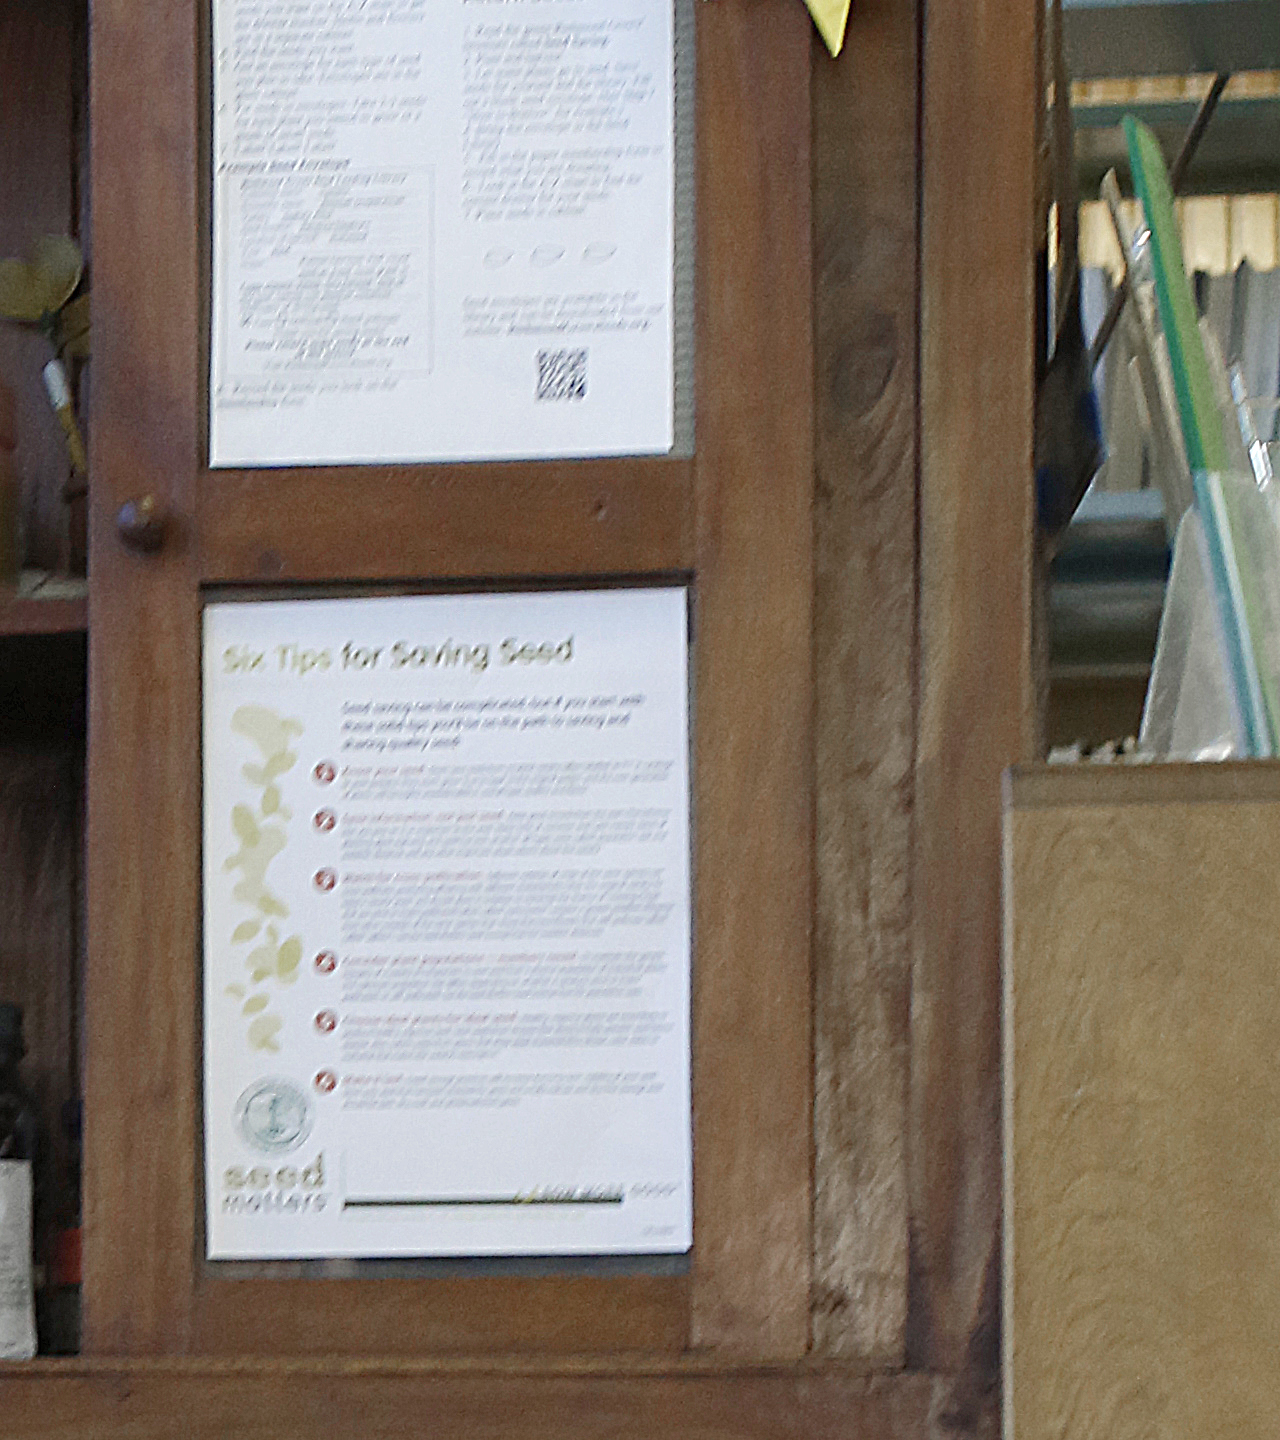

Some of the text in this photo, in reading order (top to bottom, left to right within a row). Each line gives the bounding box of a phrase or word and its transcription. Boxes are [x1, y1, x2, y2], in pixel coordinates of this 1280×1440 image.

[223, 633, 575, 675] Six Tips for Saving Seed
